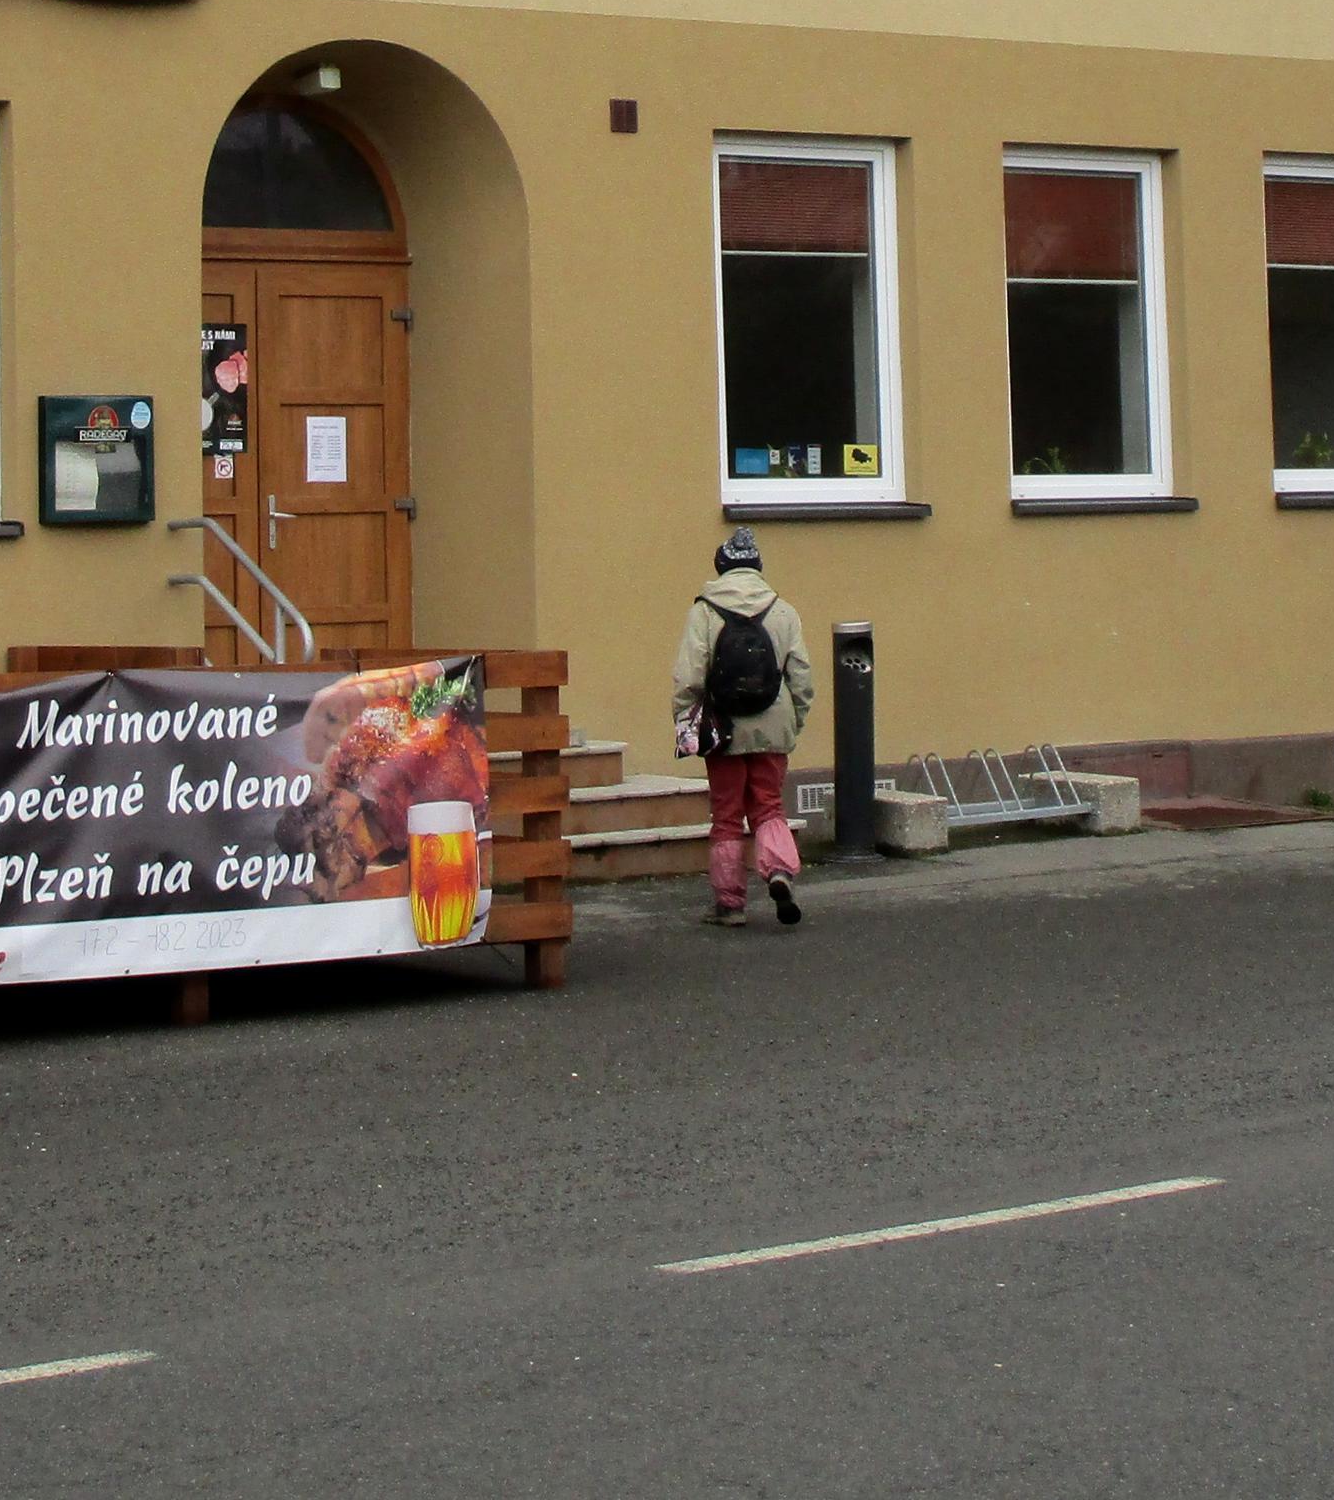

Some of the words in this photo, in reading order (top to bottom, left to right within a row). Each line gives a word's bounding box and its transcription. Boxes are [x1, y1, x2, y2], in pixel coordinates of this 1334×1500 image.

[79, 429, 128, 442] RADEGAST
[16, 693, 278, 749] Marinované
[167, 760, 312, 815] koleno
[137, 859, 193, 897] na
[216, 844, 317, 901] čepu
[196, 917, 247, 949] 2023
